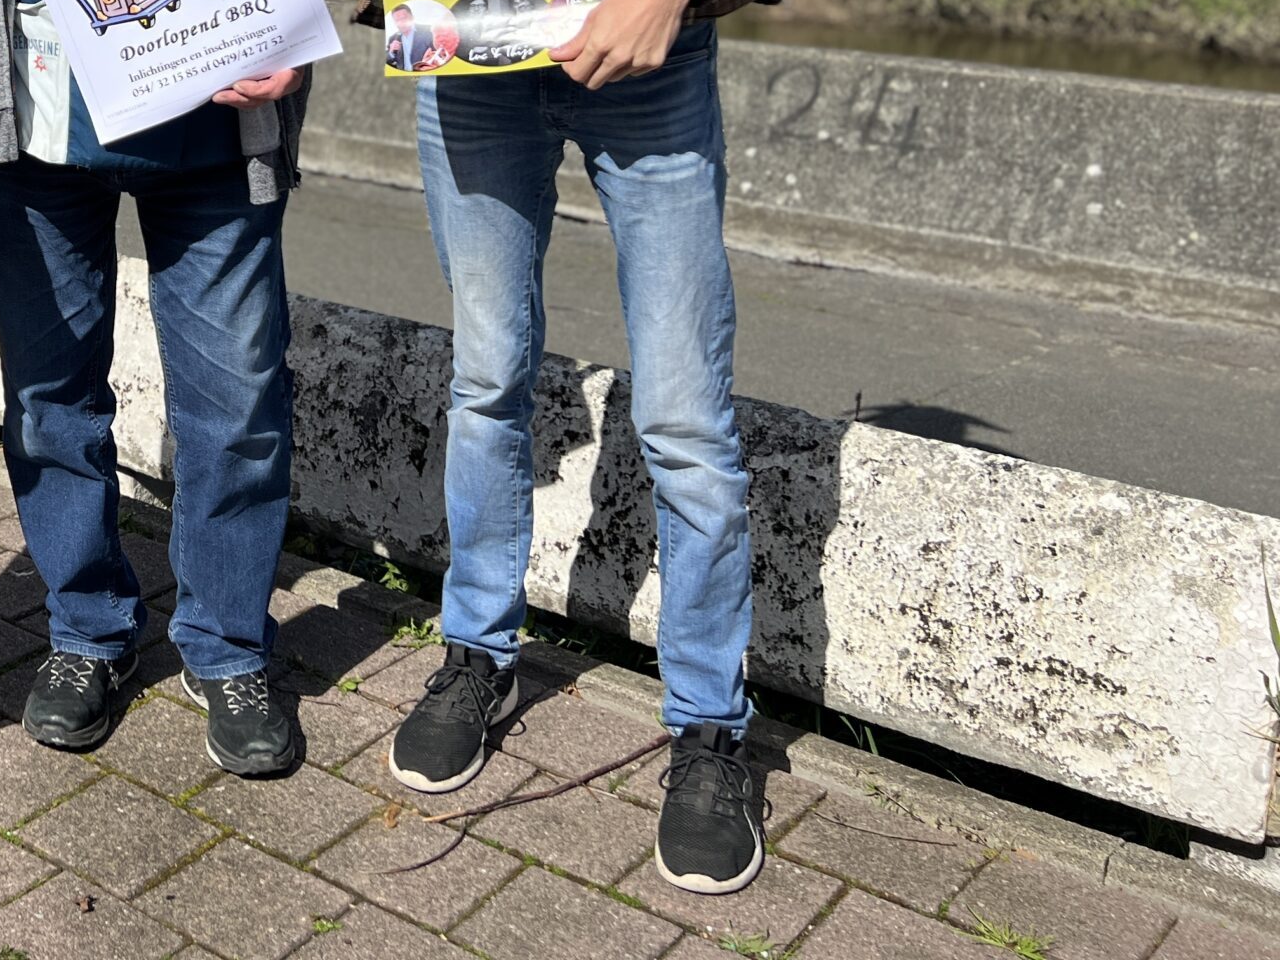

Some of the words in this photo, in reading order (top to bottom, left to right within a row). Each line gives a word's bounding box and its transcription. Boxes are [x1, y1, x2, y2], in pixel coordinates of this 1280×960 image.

[119, 11, 220, 62] Doorlopend
[128, 54, 188, 83] Inlichtingen
[189, 50, 203, 61] en
[204, 24, 278, 56] inschrijvingen:
[468, 49, 488, 61] Luc
[490, 46, 502, 57] &
[502, 44, 534, 60] Thijs
[132, 83, 155, 98] 054/
[158, 77, 170, 89] 32
[172, 72, 184, 84] 15
[185, 67, 199, 79] 85
[201, 58, 212, 73] of
[213, 45, 255, 69] 0479/42
[256, 40, 268, 53] 77
[271, 35, 284, 46] 52
